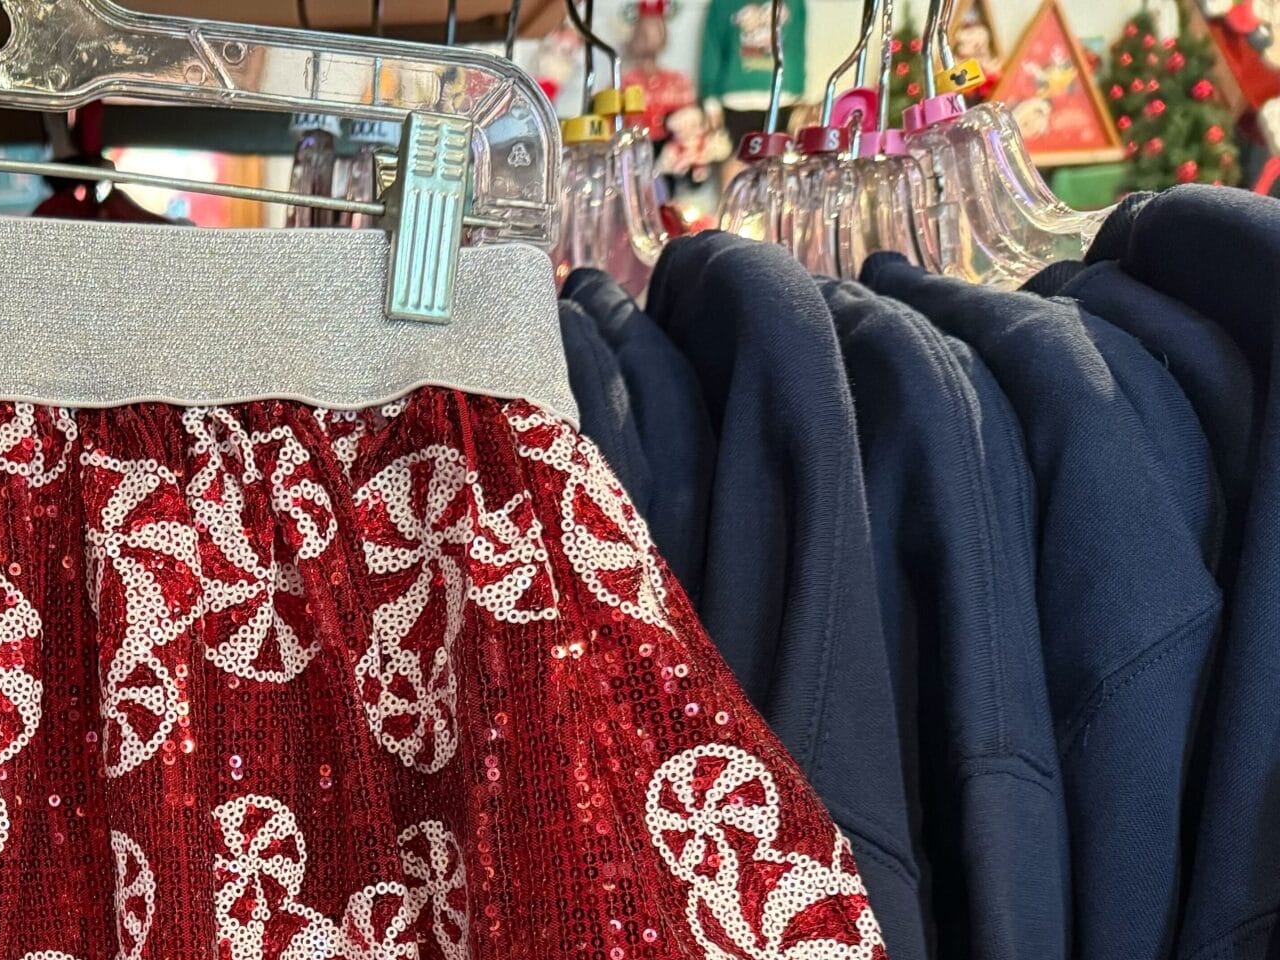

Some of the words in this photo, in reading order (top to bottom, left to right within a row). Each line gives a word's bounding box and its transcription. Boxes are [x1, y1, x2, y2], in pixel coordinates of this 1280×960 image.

[590, 119, 603, 136] M
[749, 137, 763, 154] S
[829, 129, 840, 150] S
